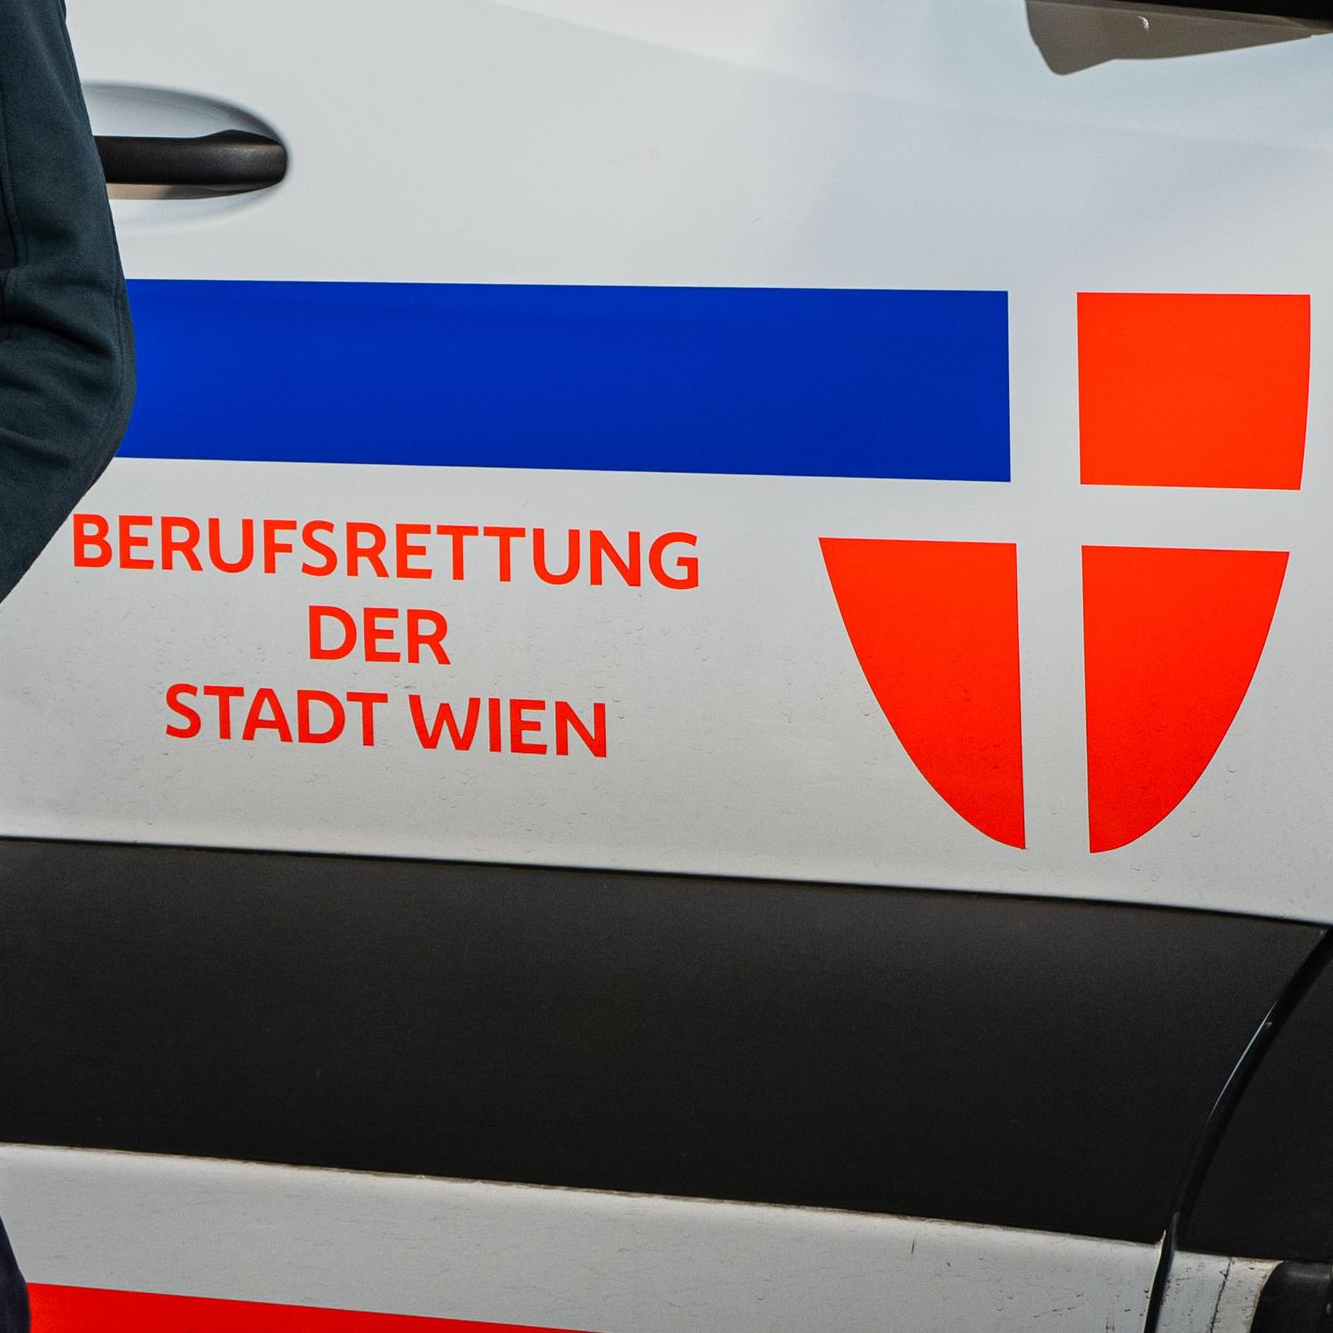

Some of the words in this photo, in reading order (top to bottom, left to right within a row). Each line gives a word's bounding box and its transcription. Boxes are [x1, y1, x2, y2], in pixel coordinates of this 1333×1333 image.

[72, 513, 700, 590] BERUFSRETTUNG
[307, 605, 452, 665] DER
[165, 683, 388, 747] STADT
[409, 694, 607, 758] WIEN
